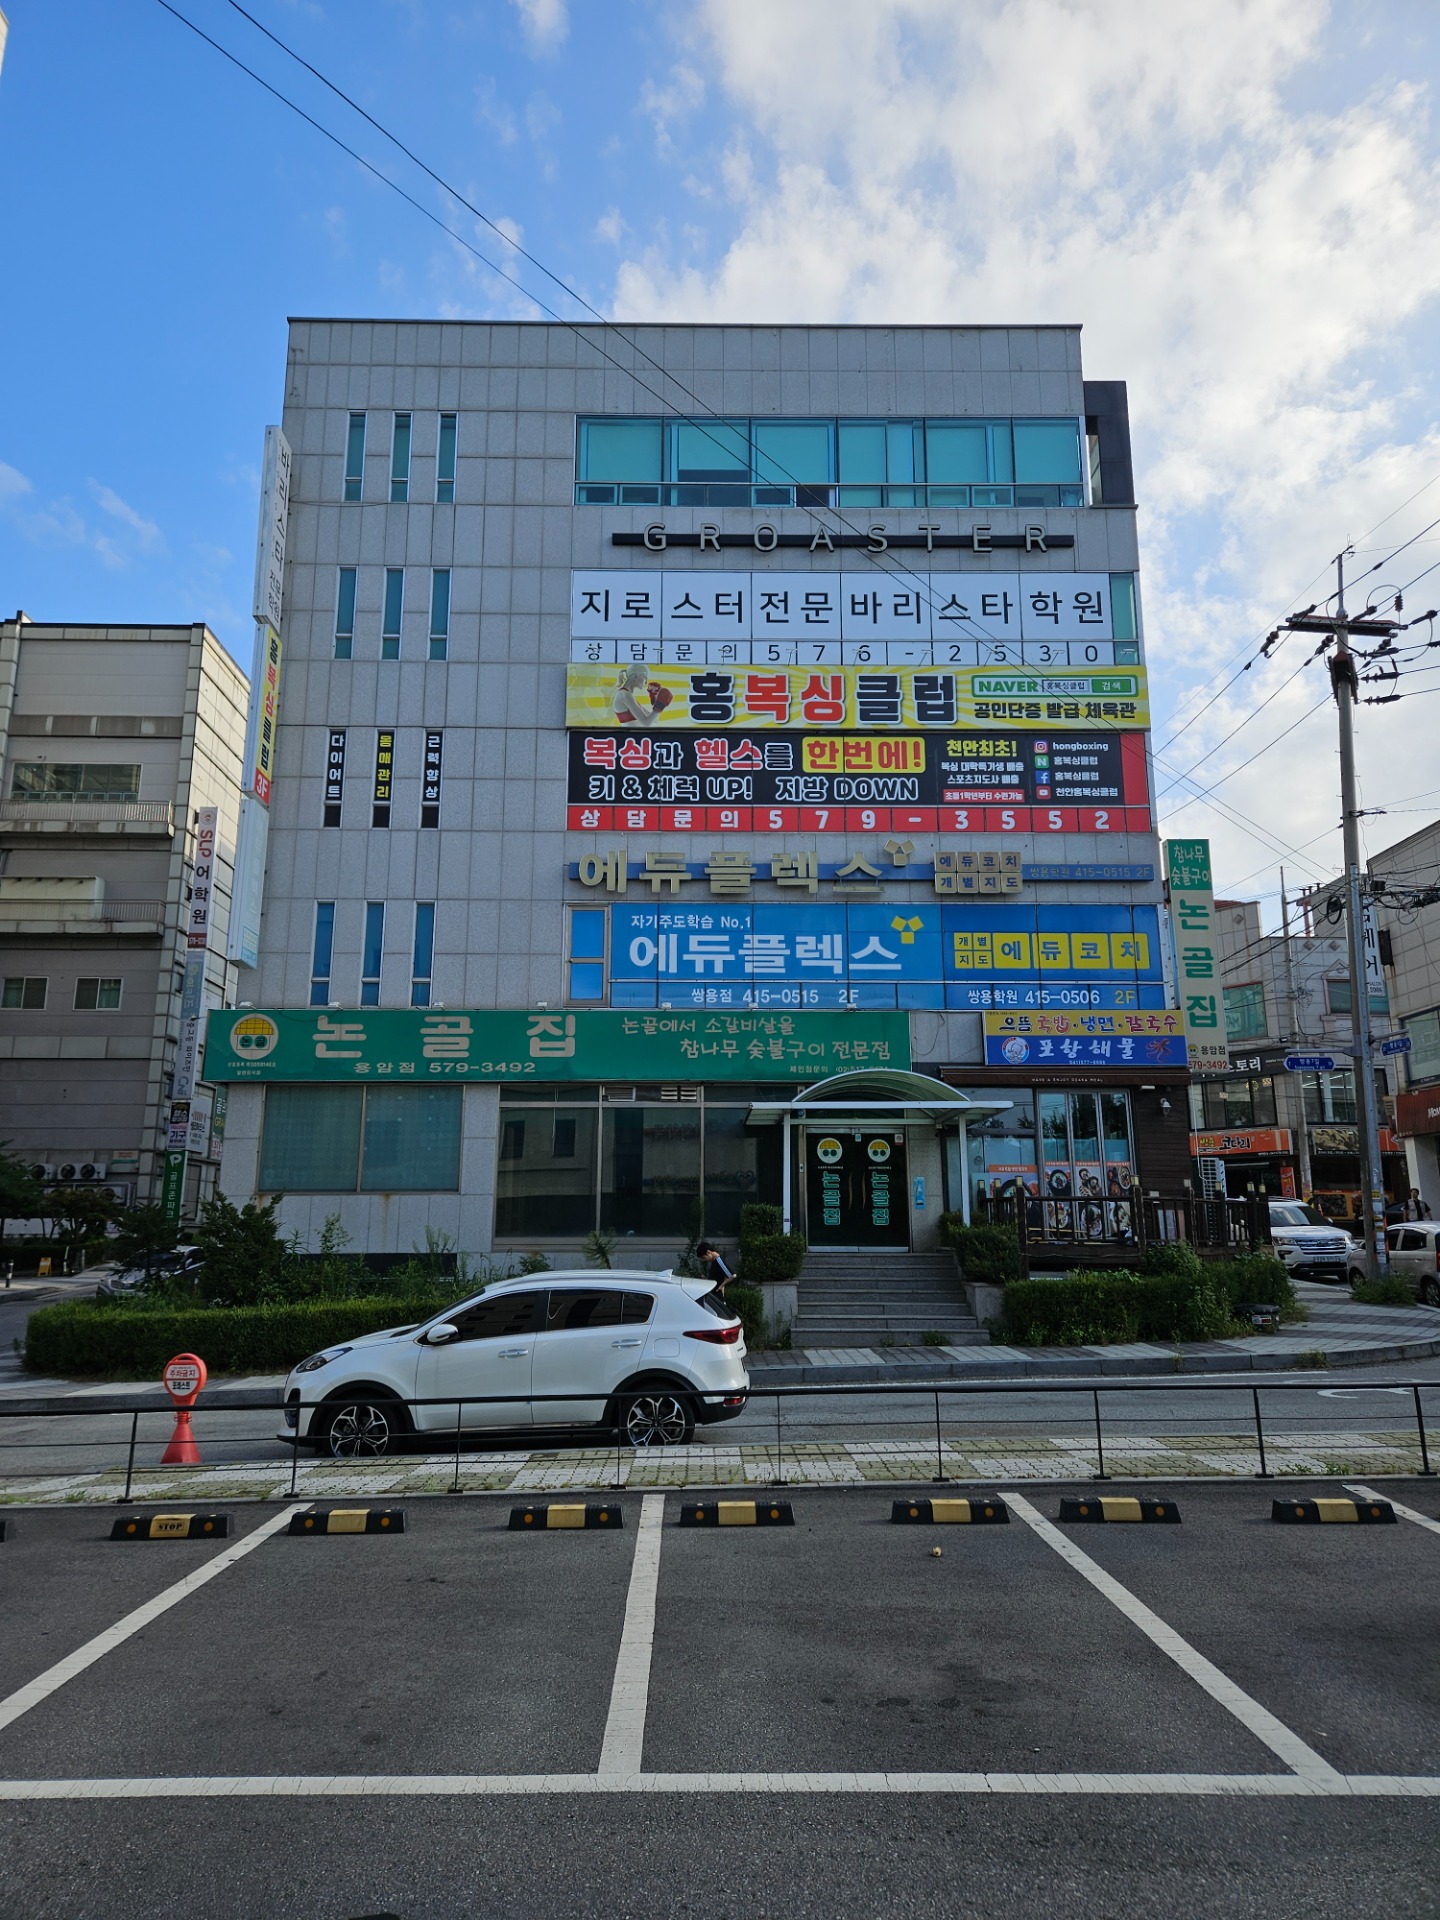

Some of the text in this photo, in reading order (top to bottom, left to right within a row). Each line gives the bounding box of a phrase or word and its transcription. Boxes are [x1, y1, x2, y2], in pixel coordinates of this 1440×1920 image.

[642, 522, 1048, 553] GROASTER
[585, 643, 1099, 662] 상담문의 576-2530
[978, 680, 1121, 693] NAVER 홍복싱클럽 검색
[687, 670, 958, 725] 홍복싱클럽
[973, 701, 1137, 720] 공인단증 발급 체육관
[583, 736, 922, 771] 복싱과 헬스를 한번에!
[945, 738, 1018, 758] 천안최초!
[1052, 742, 1109, 752] hongboxing
[326, 735, 345, 798] 다이어트
[375, 735, 393, 798] 몸매관리
[425, 736, 440, 798] 근력향상
[940, 761, 959, 772] 복싱
[256, 774, 269, 798] 3F
[588, 775, 920, 801] 키 & 체력 UP! 지방 DOWN
[946, 774, 1000, 785] 스포츠지도사
[580, 809, 1110, 830] 상담문의 579-3552
[1173, 844, 1205, 863] 참나무
[578, 849, 886, 895] 에듀플렉스
[938, 854, 1019, 869] 에듀코치
[1075, 865, 1132, 879] 415-0515
[1136, 866, 1150, 878] 2F
[1170, 865, 1211, 886] 숯불구이
[939, 875, 1019, 890] 개별지도
[192, 865, 210, 925] 어학원
[631, 914, 752, 930] 자기주도학습 No.1
[958, 935, 988, 947] 개별
[1000, 939, 1142, 962] 에듀코치
[629, 933, 903, 974] 에듀플렉스
[959, 953, 989, 966] 지도
[1178, 898, 1219, 1029] 논골집
[691, 988, 860, 1004] 쌍용점 415-0515 2F
[967, 989, 1136, 1004] 쌍용학원 415-0506 2F
[622, 1016, 796, 1036] 논골에서 소갈비살을
[998, 1015, 1033, 1033] 으뜸
[312, 1014, 576, 1059] 논골집
[680, 1038, 891, 1060] 참나무 숯불구이 전문점
[1037, 1037, 1136, 1060] 포항해물
[1200, 1045, 1227, 1056] 용암점
[353, 1062, 536, 1074] 용암점 579-3492
[1188, 1059, 1228, 1070] 579-3492
[1218, 1131, 1251, 1151] 코다리
[165, 1171, 179, 1218] 골프존파크
[821, 1170, 841, 1226] 논골집
[870, 1171, 890, 1226] 논골집
[169, 1369, 196, 1378] 주차금지
[156, 1522, 184, 1533] STOP
